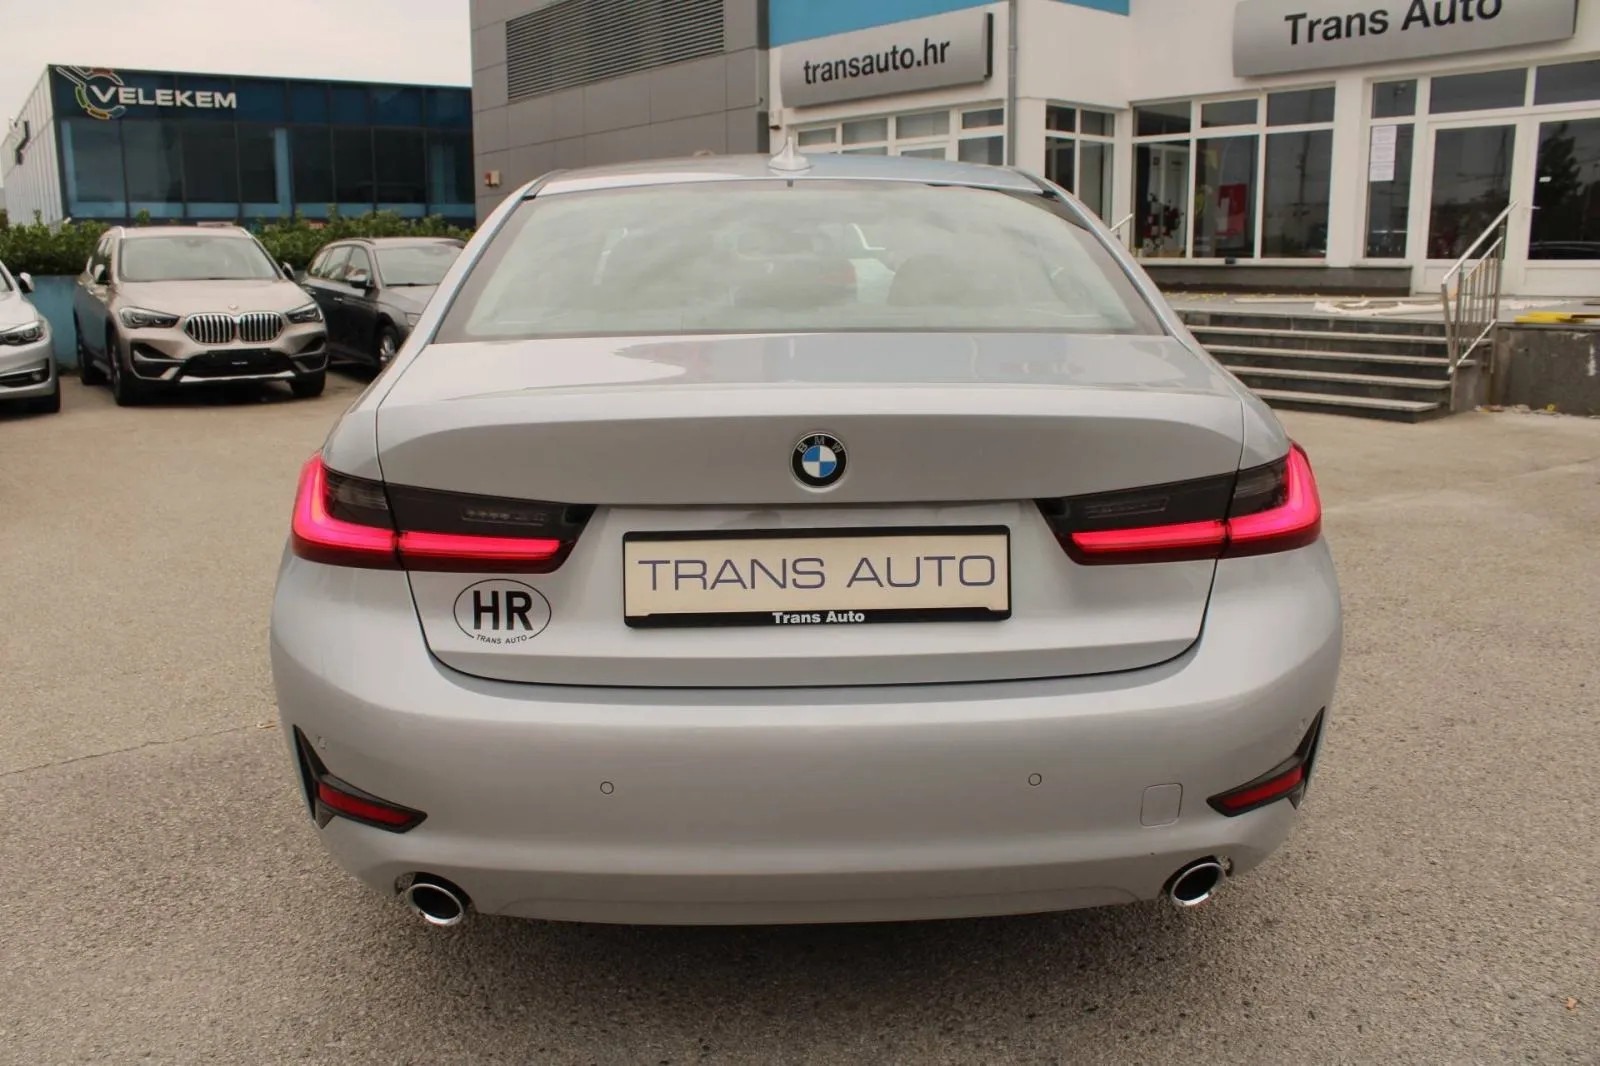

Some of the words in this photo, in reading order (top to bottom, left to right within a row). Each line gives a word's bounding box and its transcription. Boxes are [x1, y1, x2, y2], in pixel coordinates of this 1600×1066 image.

[1284, 9, 1389, 45] Trans
[1401, 0, 1503, 31] Auto
[803, 38, 950, 84] transauto.hr
[89, 84, 237, 109] VELEKEM
[797, 435, 842, 454] BMW
[638, 556, 826, 591] TRANS
[846, 555, 995, 588] AUTO
[473, 590, 533, 631] HR
[772, 611, 821, 624] Trans
[825, 610, 865, 623] Auto
[476, 634, 502, 644] TRANS
[505, 634, 527, 644] AUTO
